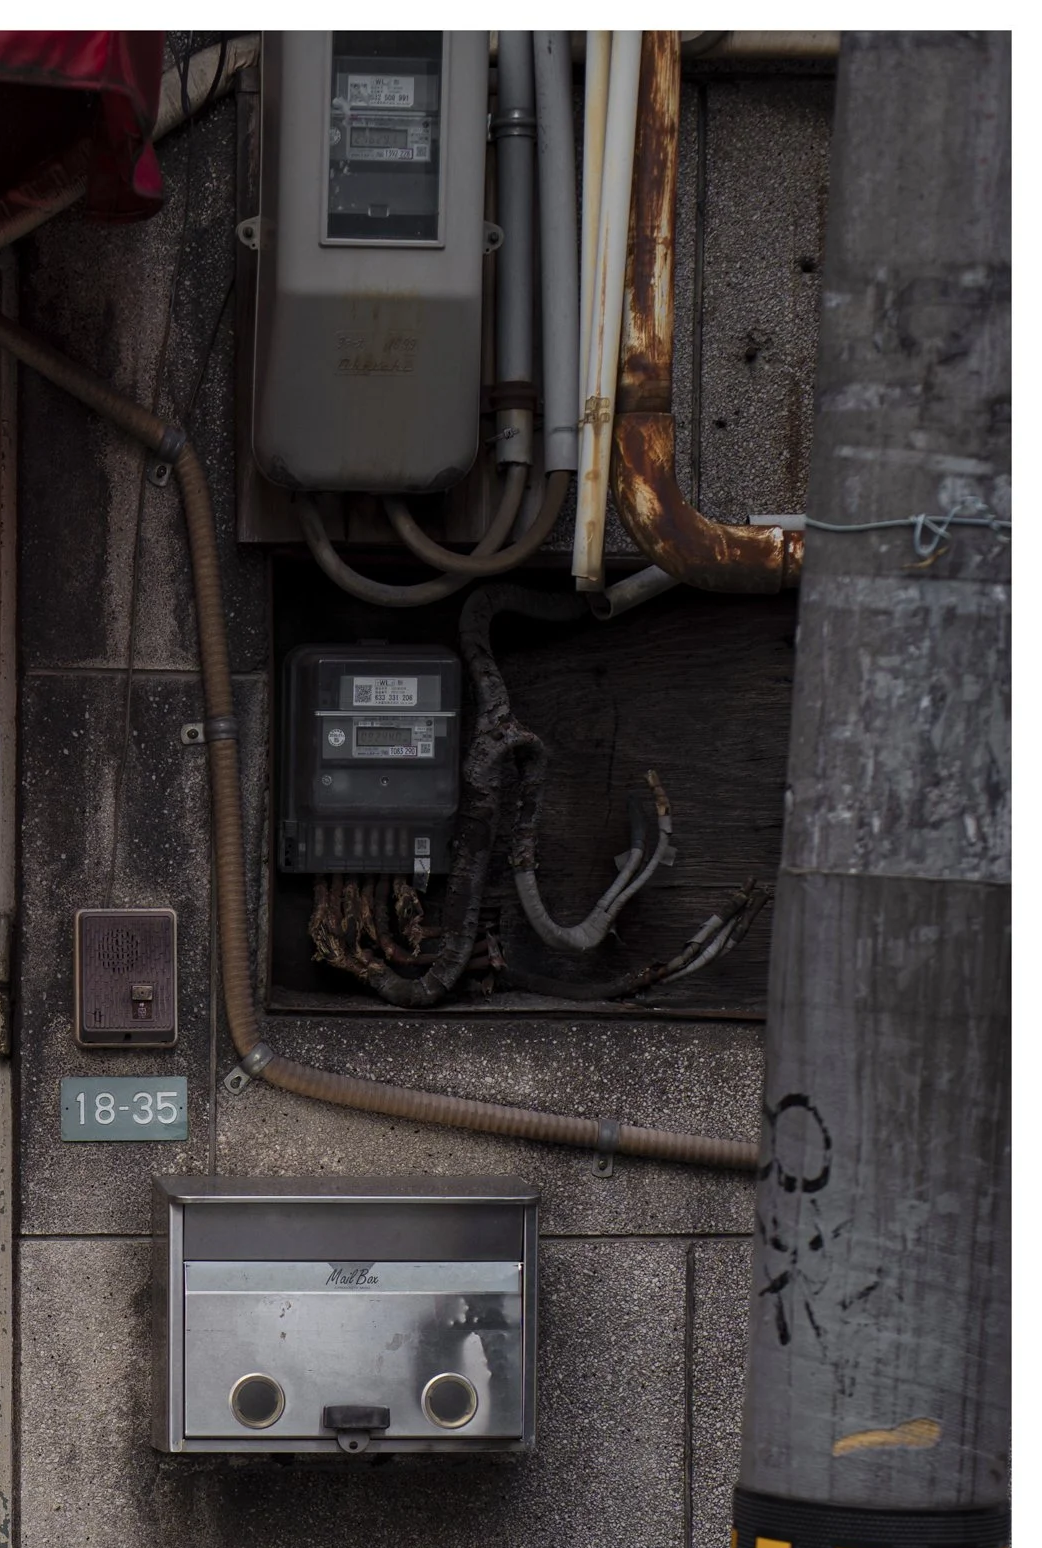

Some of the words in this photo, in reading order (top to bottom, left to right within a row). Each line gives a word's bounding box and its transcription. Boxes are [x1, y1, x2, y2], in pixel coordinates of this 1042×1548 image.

[75, 1091, 178, 1125] 18-35
[325, 1268, 359, 1286] Mail
[355, 1268, 379, 1286] Box
